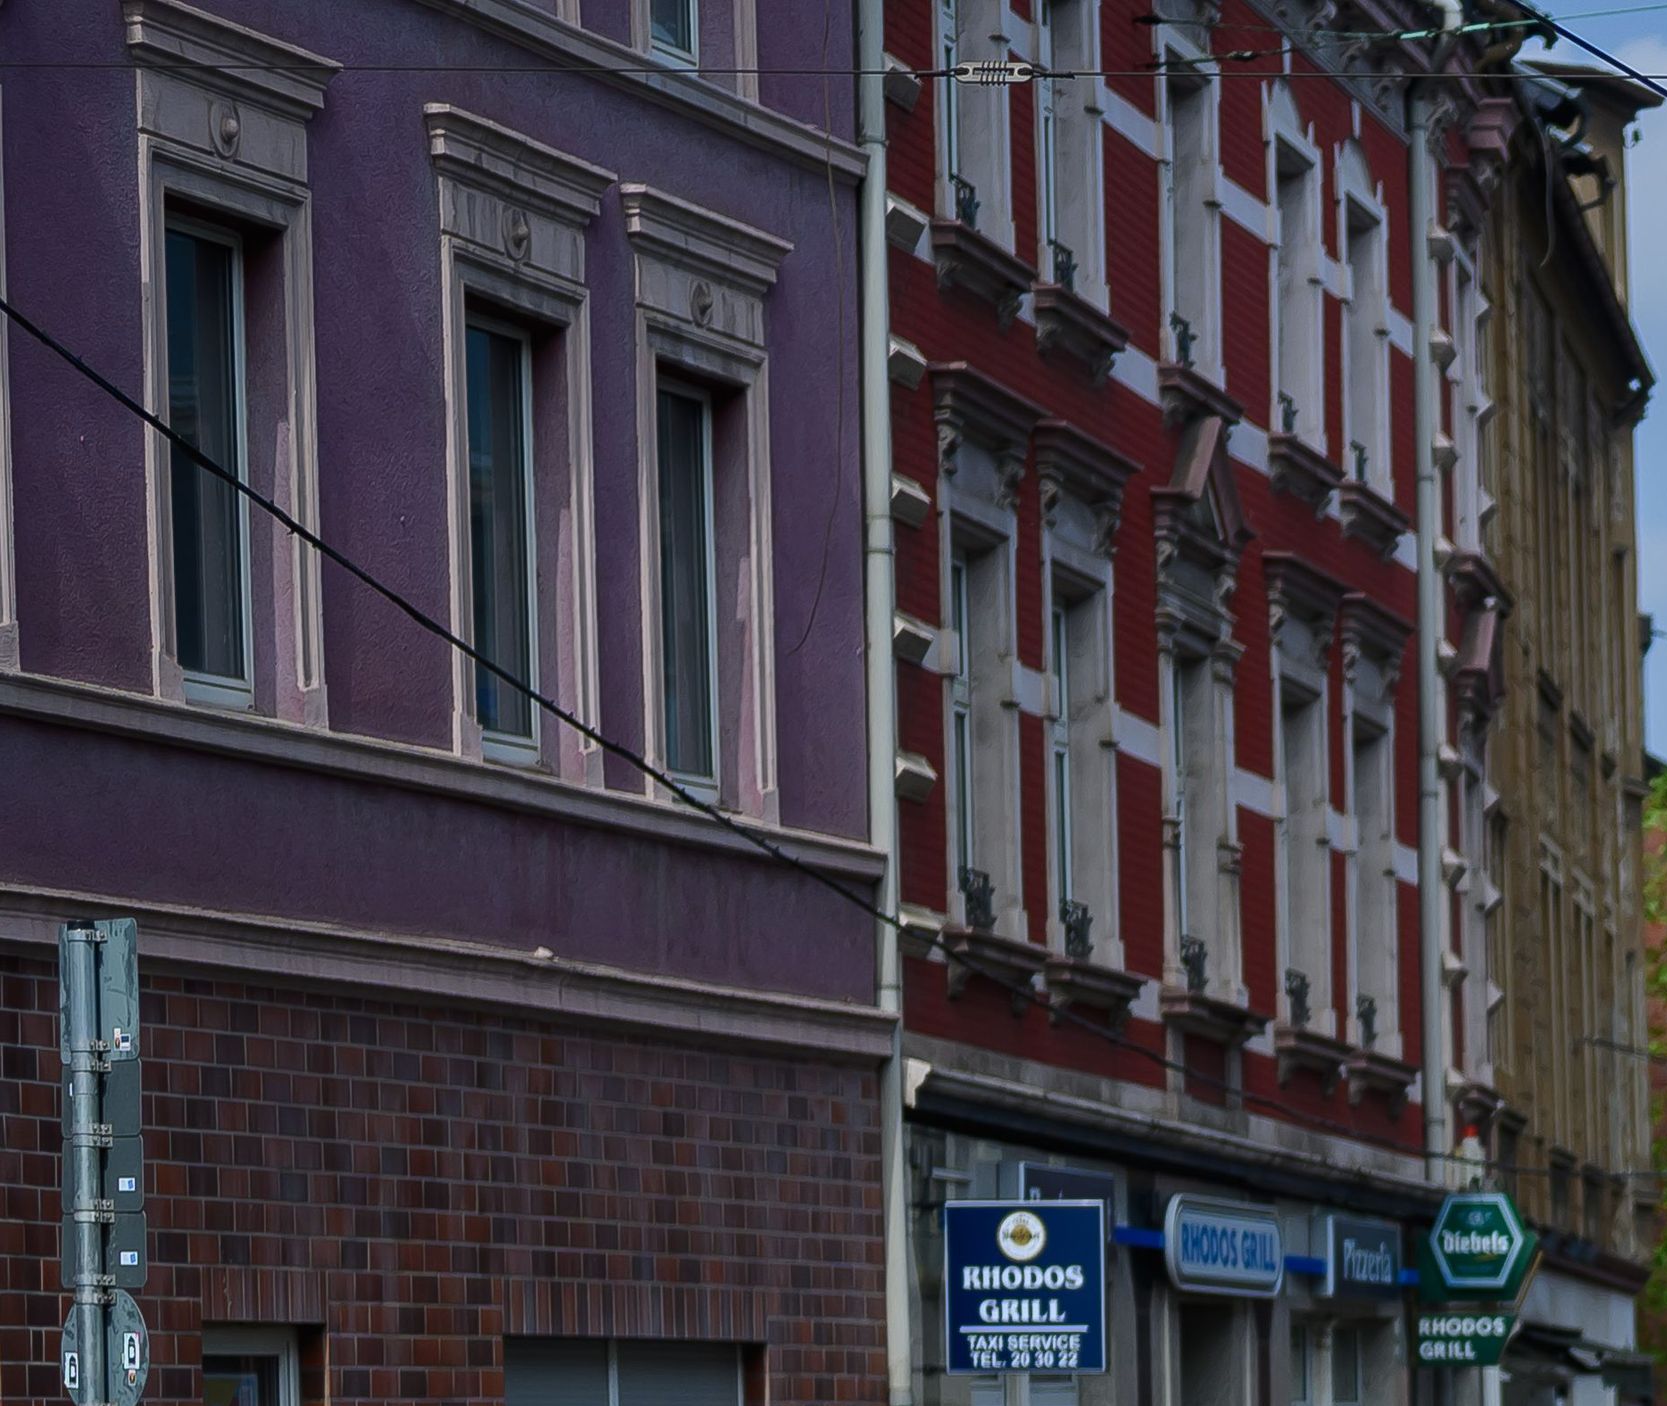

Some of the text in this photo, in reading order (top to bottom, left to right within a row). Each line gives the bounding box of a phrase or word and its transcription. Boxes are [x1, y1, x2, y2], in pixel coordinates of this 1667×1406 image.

[1181, 1222, 1276, 1273] RHODOS GRILL
[1441, 1229, 1509, 1254] Diebels
[1343, 1238, 1392, 1285] Pizzeria
[962, 1264, 1084, 1290] RHODOS
[978, 1298, 1066, 1323] GRILL
[1418, 1317, 1506, 1337] RHODOS
[967, 1334, 1081, 1351] TAXI SERVICE
[1419, 1340, 1476, 1360] GRILL
[970, 1351, 1078, 1368] TEL. 20 30 22
